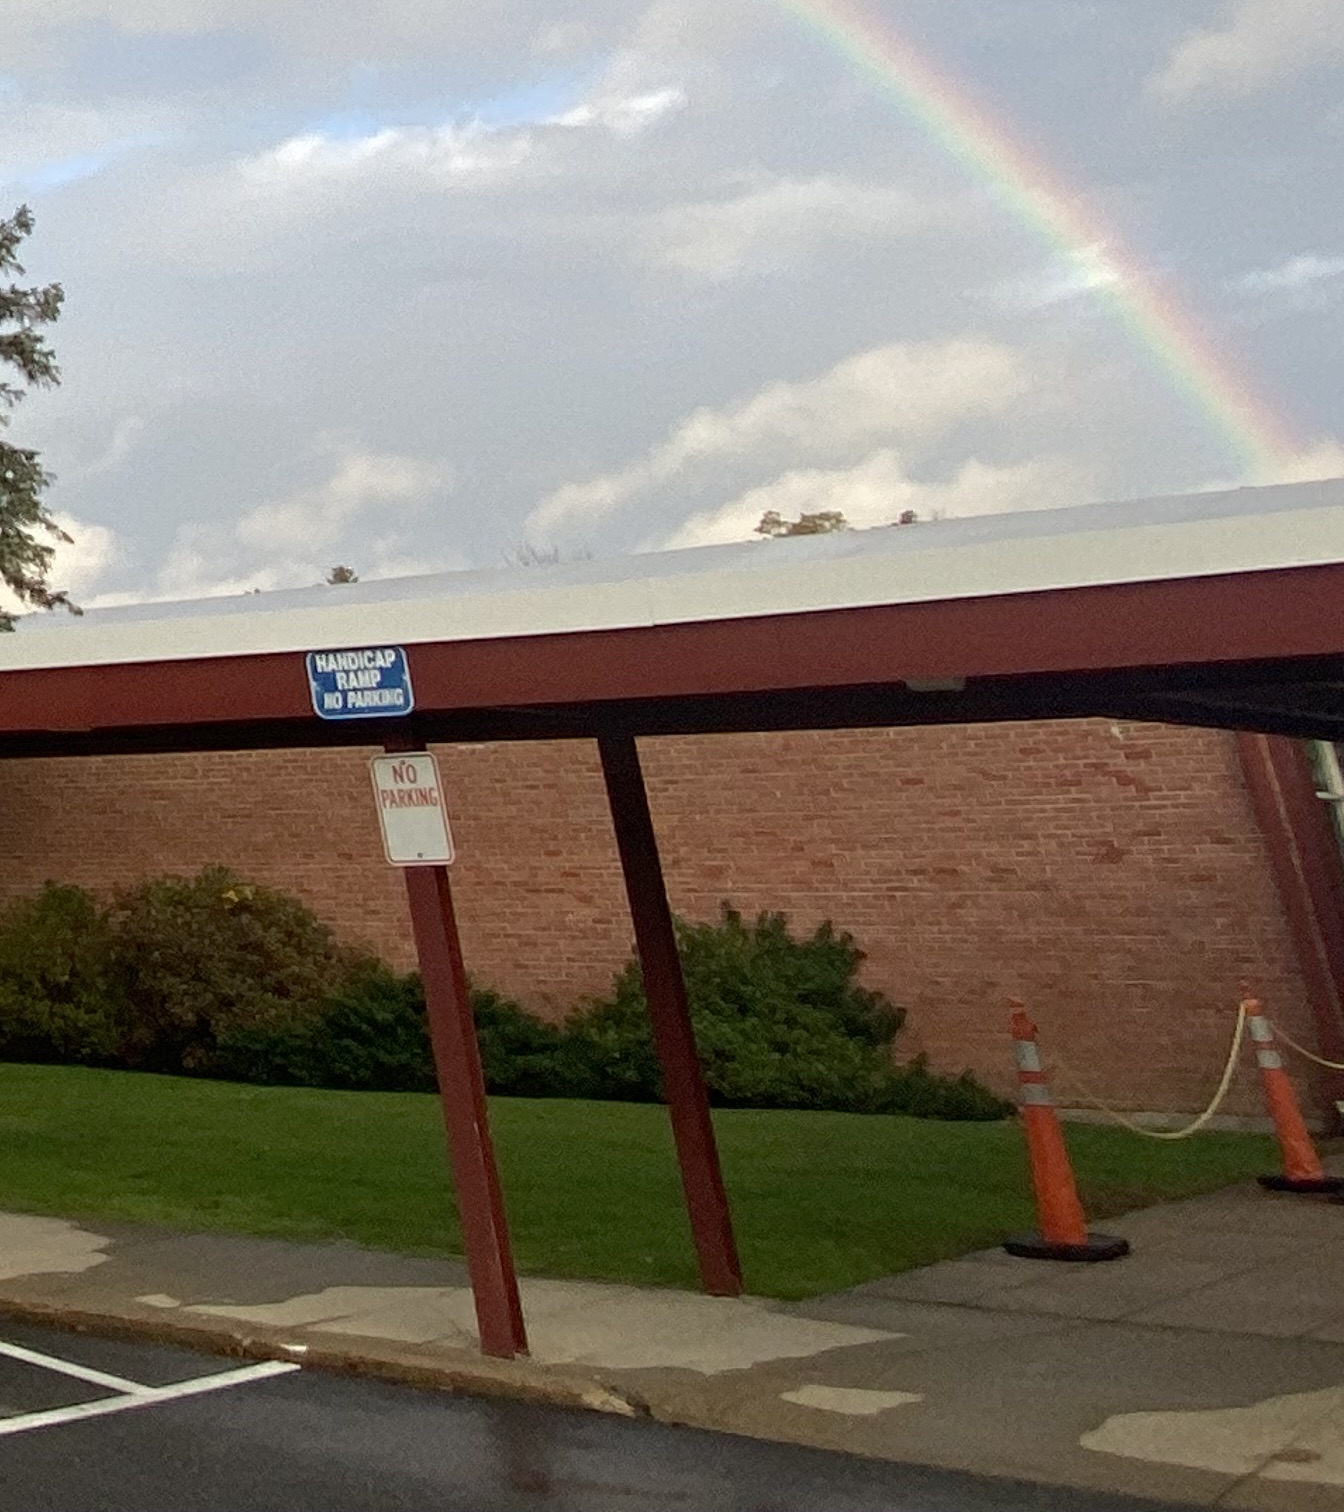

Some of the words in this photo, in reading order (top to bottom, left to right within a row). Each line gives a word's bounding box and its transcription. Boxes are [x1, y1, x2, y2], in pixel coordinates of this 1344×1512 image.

[315, 650, 395, 672] HANDICAP
[336, 669, 381, 690] RAMP
[324, 692, 342, 709] NO
[347, 688, 403, 708] PARKING
[392, 764, 417, 784] NO
[381, 788, 438, 808] PARKING
